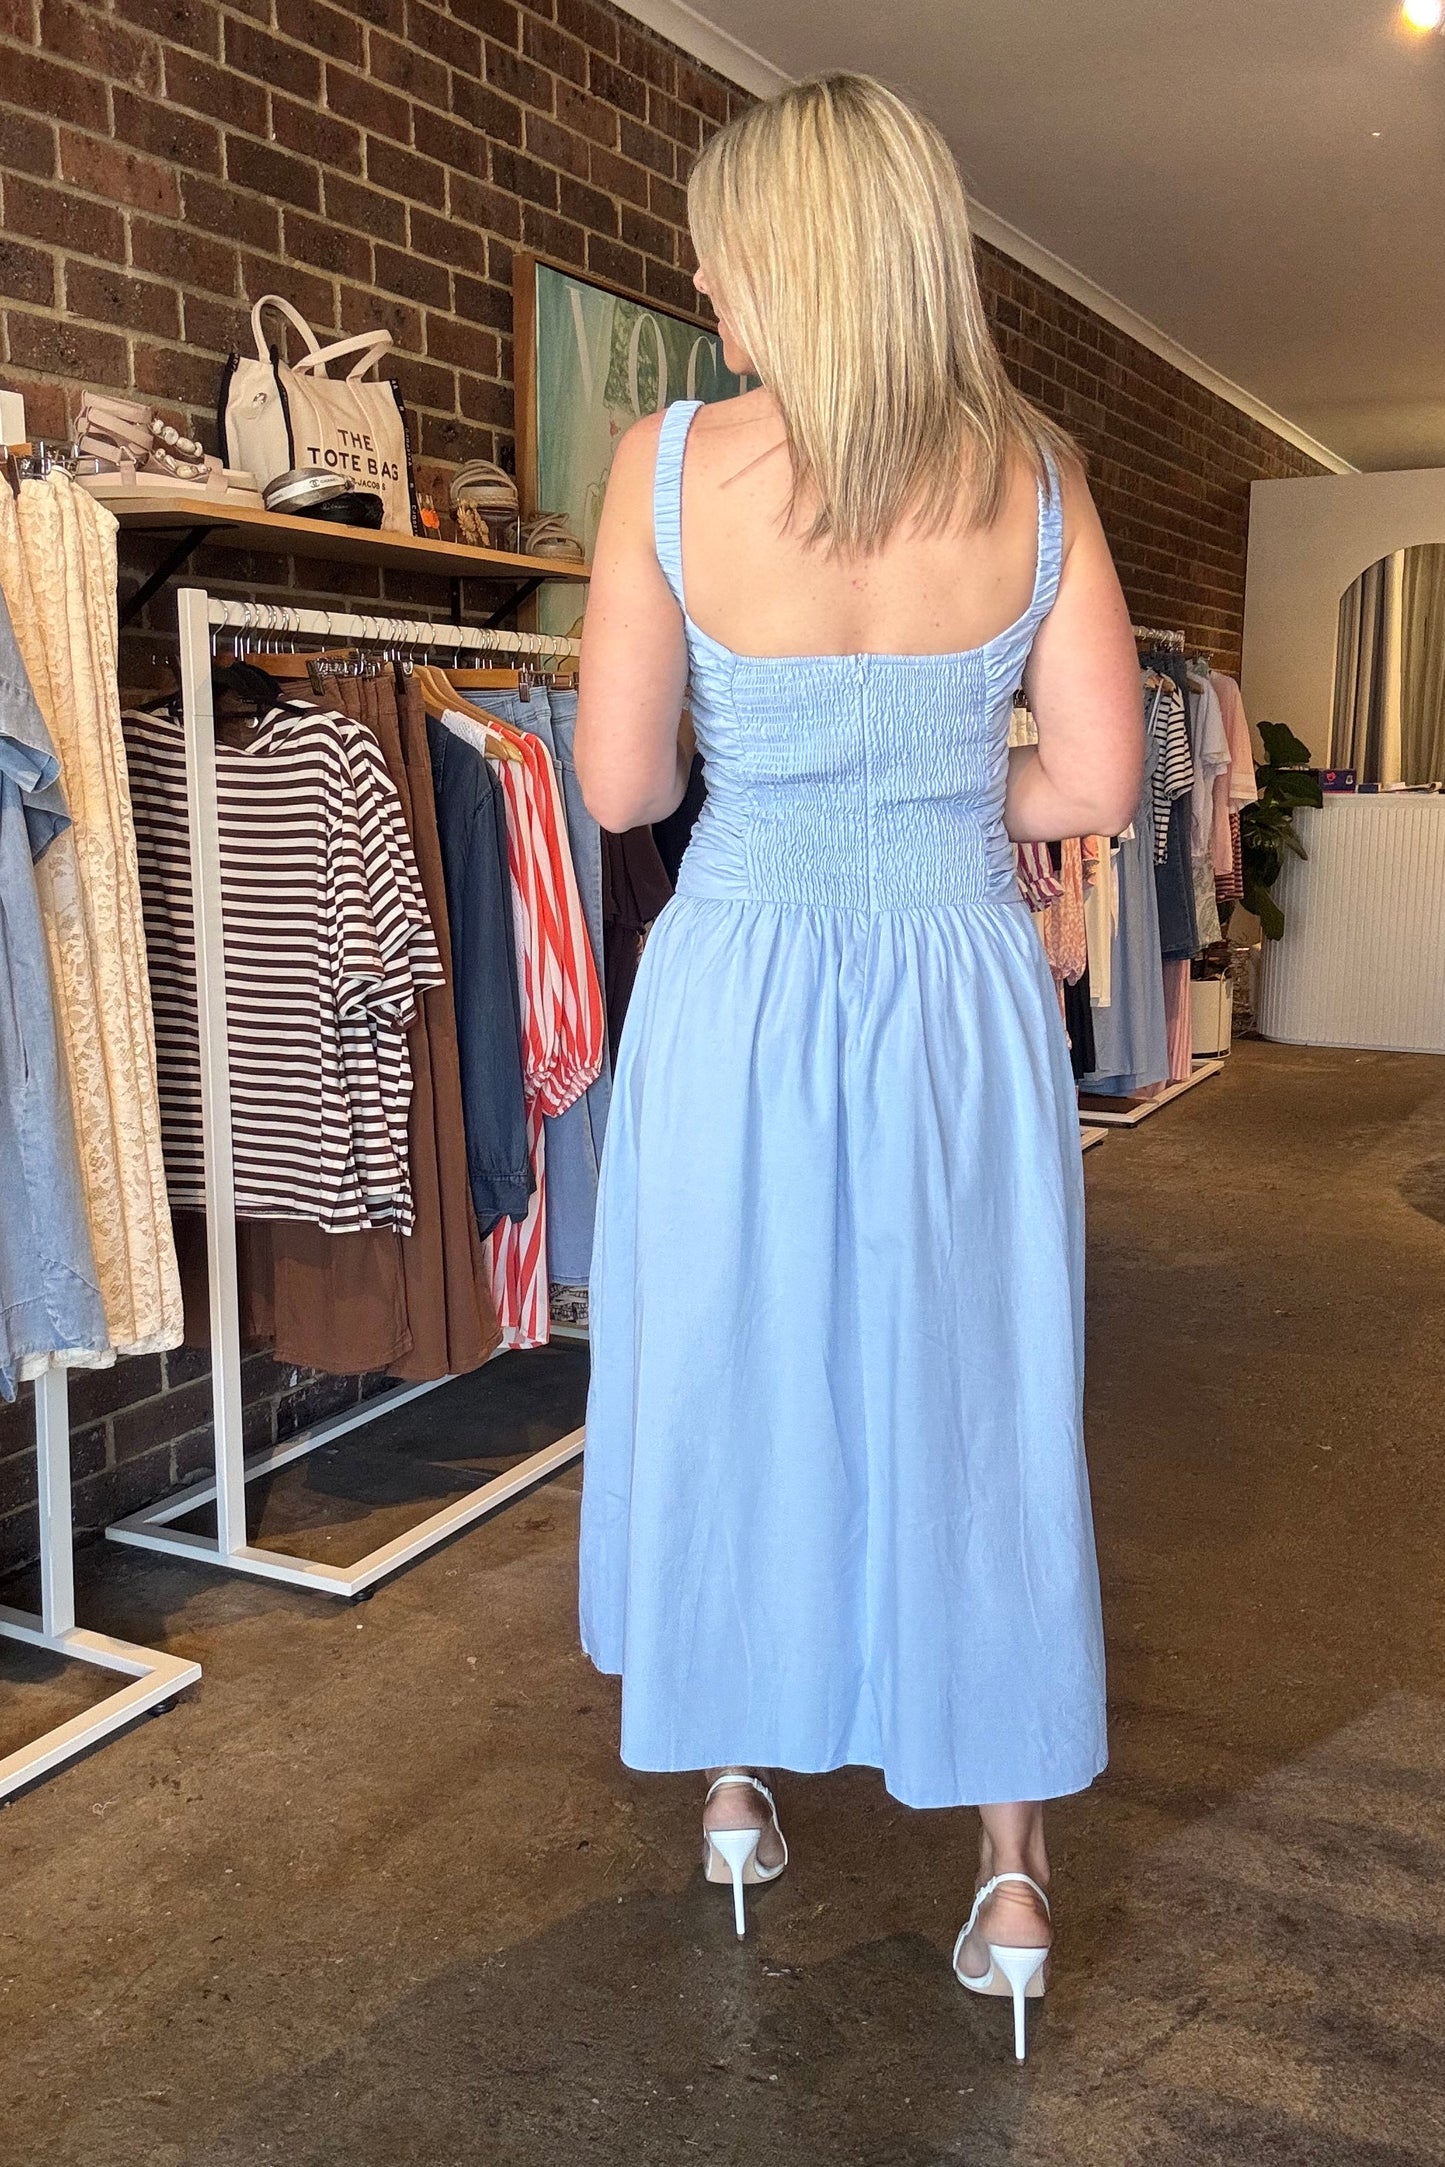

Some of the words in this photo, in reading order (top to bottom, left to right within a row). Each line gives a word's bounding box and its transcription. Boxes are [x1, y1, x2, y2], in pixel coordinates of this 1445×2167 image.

[337, 428, 374, 452] THE
[307, 446, 361, 472] TOTE
[367, 458, 399, 481] BAG
